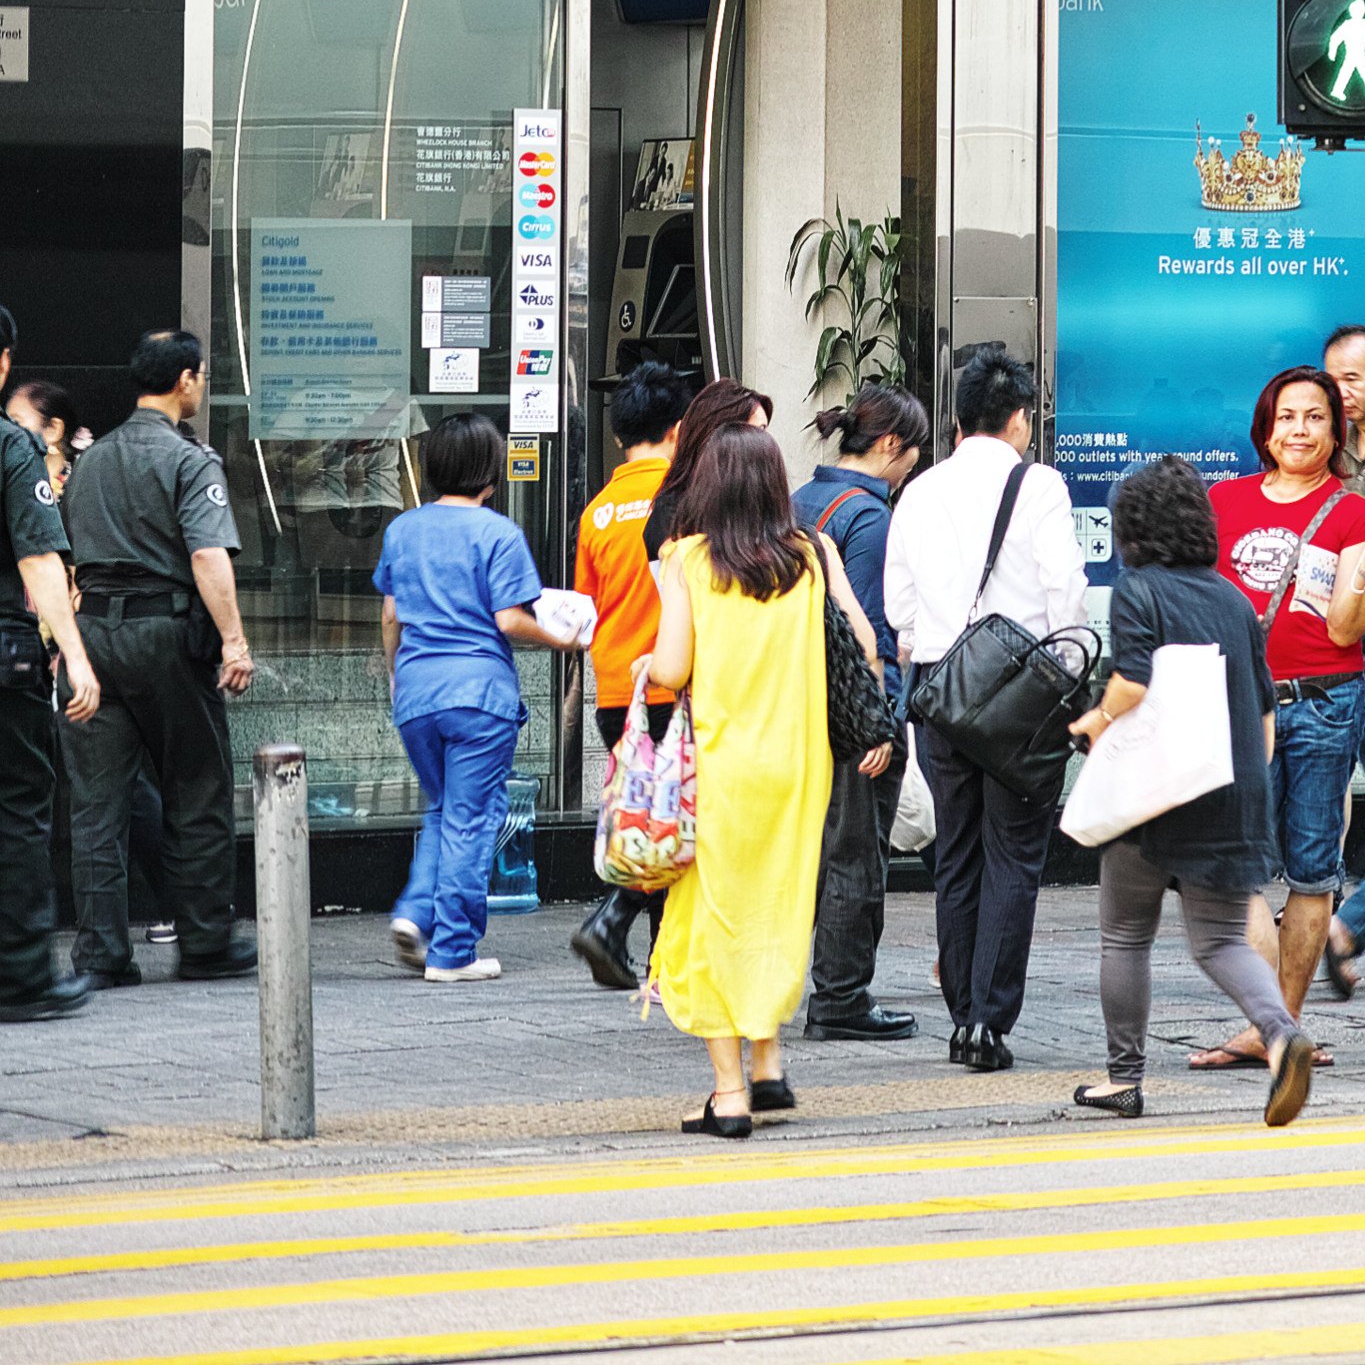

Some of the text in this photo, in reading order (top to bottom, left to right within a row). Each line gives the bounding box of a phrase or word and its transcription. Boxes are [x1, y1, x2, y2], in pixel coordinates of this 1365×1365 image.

[448, 139, 467, 147] HOUSE
[468, 139, 492, 147] BRANCH
[520, 160, 556, 171] MasterCard
[522, 221, 552, 233] Cirrus
[261, 235, 300, 248] Citigold
[520, 254, 552, 267] VISA
[1158, 255, 1235, 275] Rewards
[1241, 256, 1262, 275] all
[1268, 261, 1308, 275] over
[528, 295, 554, 307] PLUS
[514, 441, 534, 449] VISA
[1078, 451, 1116, 463] outlets
[1119, 450, 1142, 463] with
[1205, 449, 1239, 463] offers.
